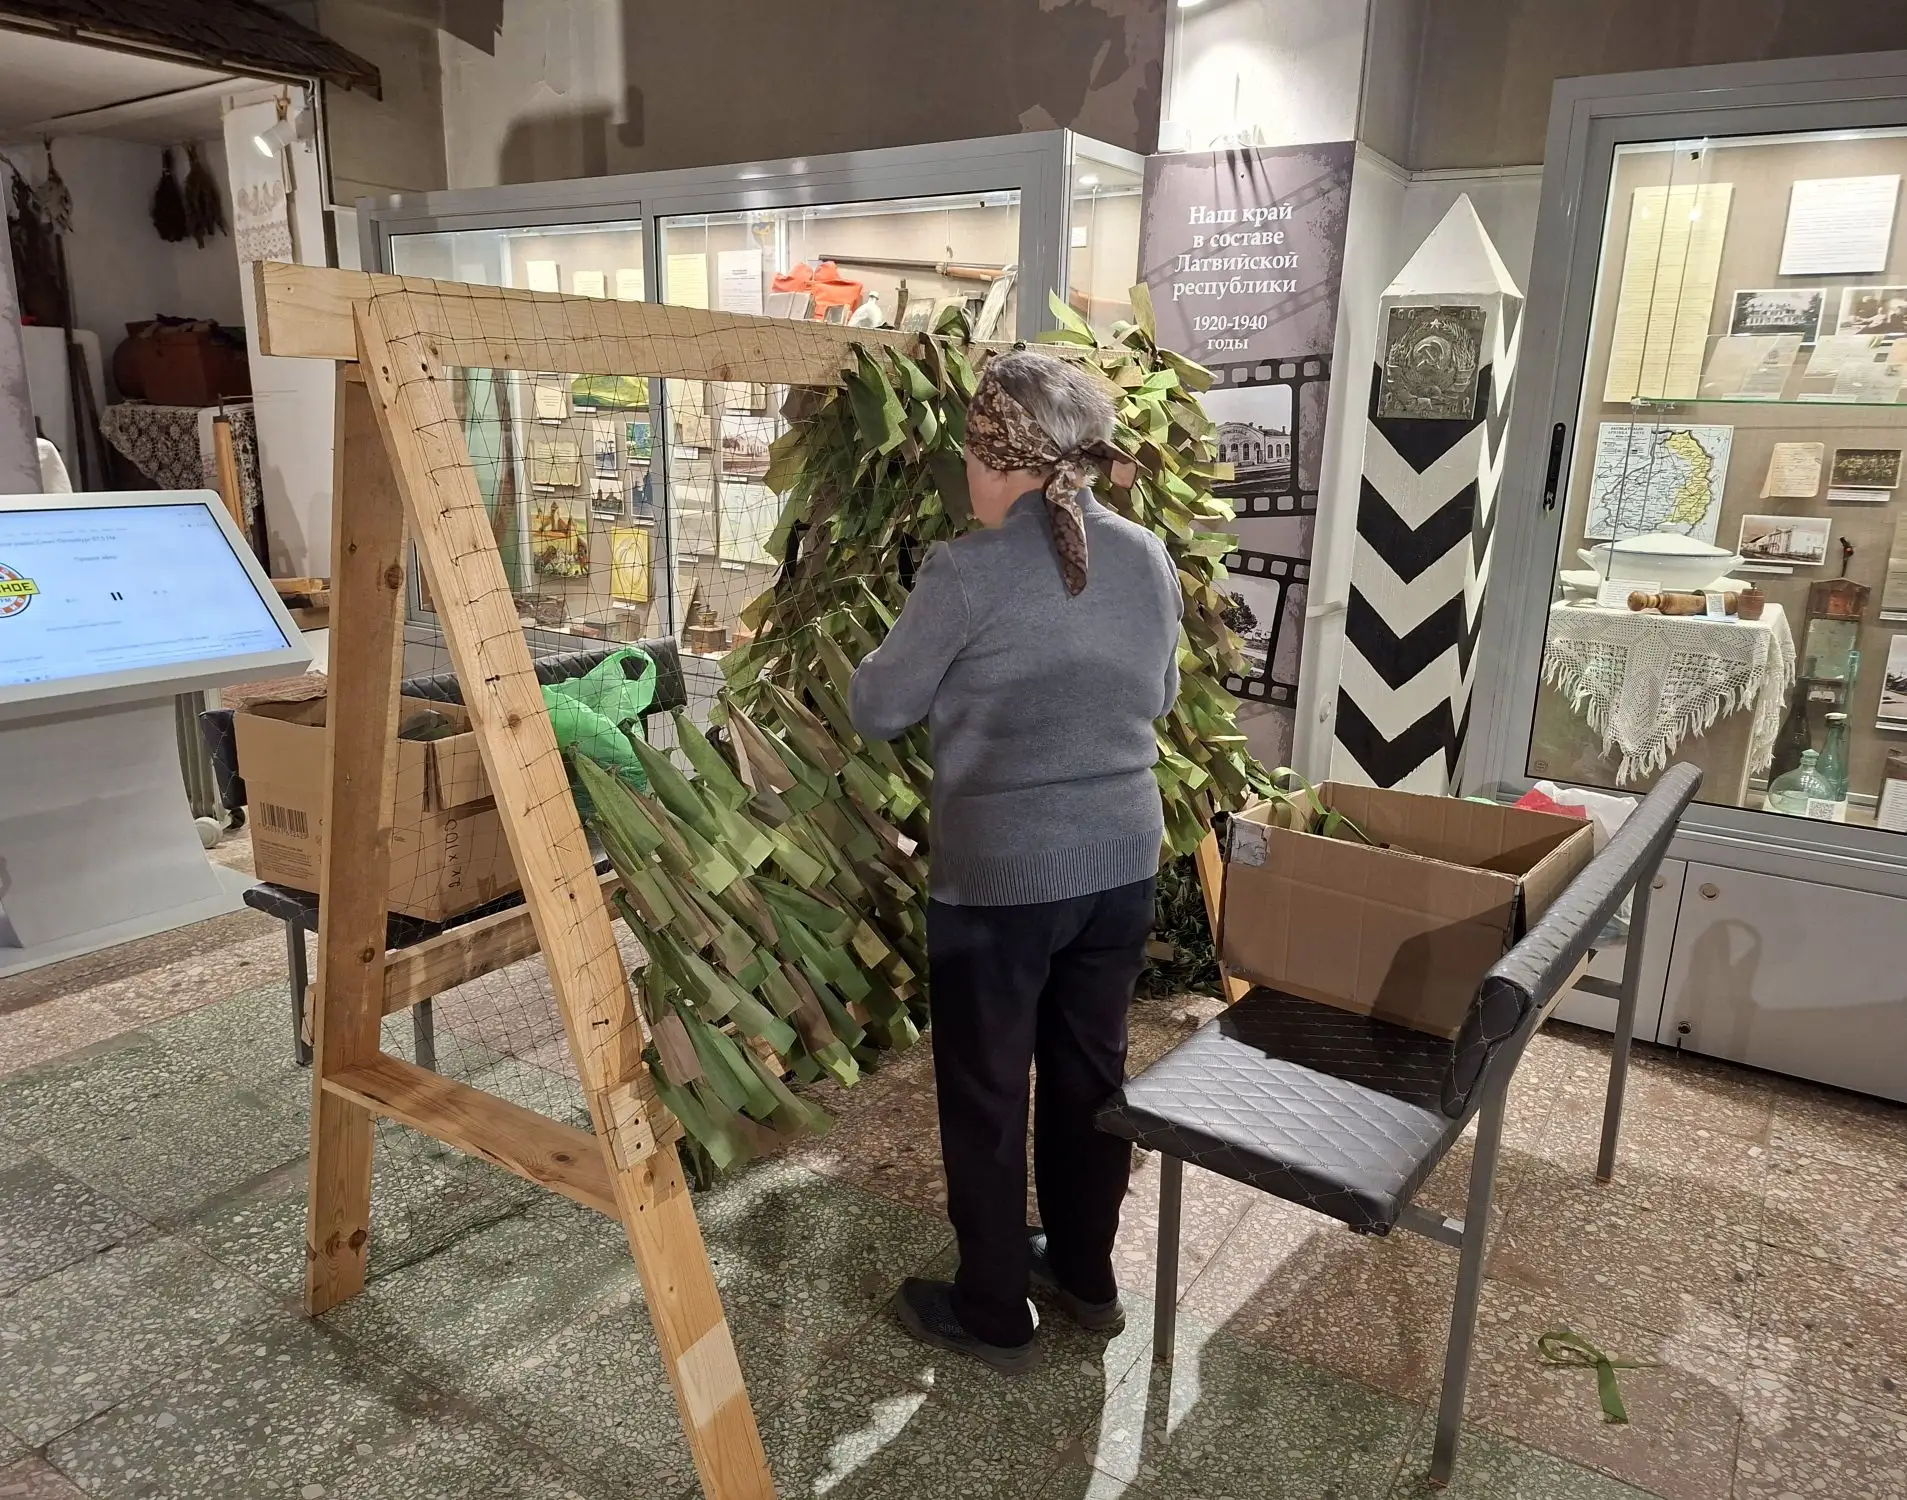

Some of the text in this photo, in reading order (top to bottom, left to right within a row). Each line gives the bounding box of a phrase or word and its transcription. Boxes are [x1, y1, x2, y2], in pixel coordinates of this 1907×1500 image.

[1188, 203, 1293, 227] Наш край
[1193, 231, 1285, 248] в составе
[1174, 251, 1299, 273] Латвийской
[1172, 276, 1297, 301] республики
[1193, 314, 1268, 331] 1920-1940
[1207, 337, 1249, 351] годы
[0, 582, 33, 592] НОЕ
